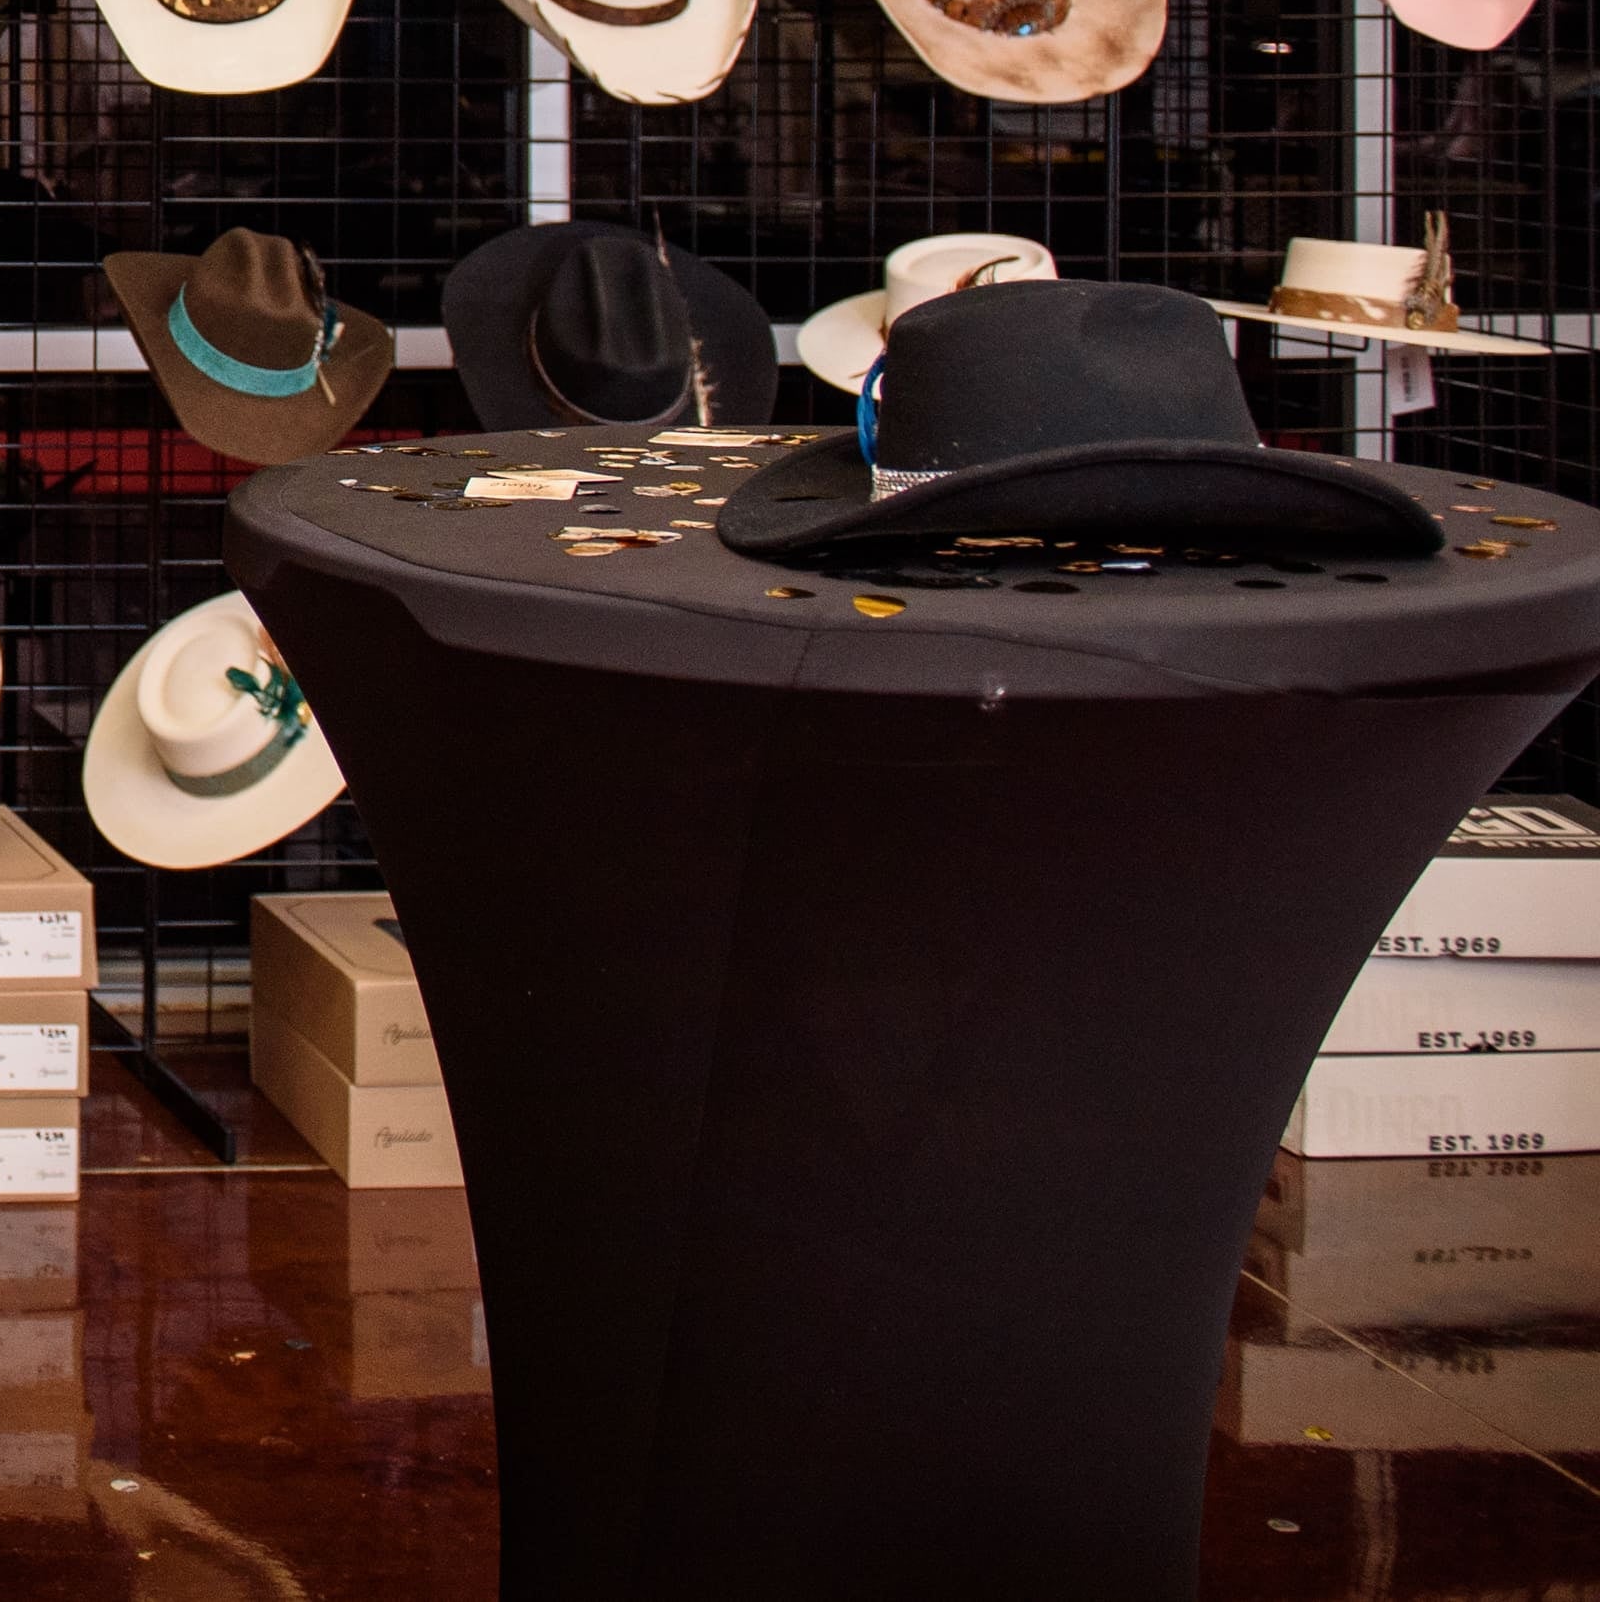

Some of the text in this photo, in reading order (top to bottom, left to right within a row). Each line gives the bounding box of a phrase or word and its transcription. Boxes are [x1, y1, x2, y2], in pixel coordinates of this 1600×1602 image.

[1377, 936, 1501, 953] EST. 1969
[1418, 1030, 1536, 1048] EST. 1969
[1429, 1133, 1545, 1152] EST. 1969
